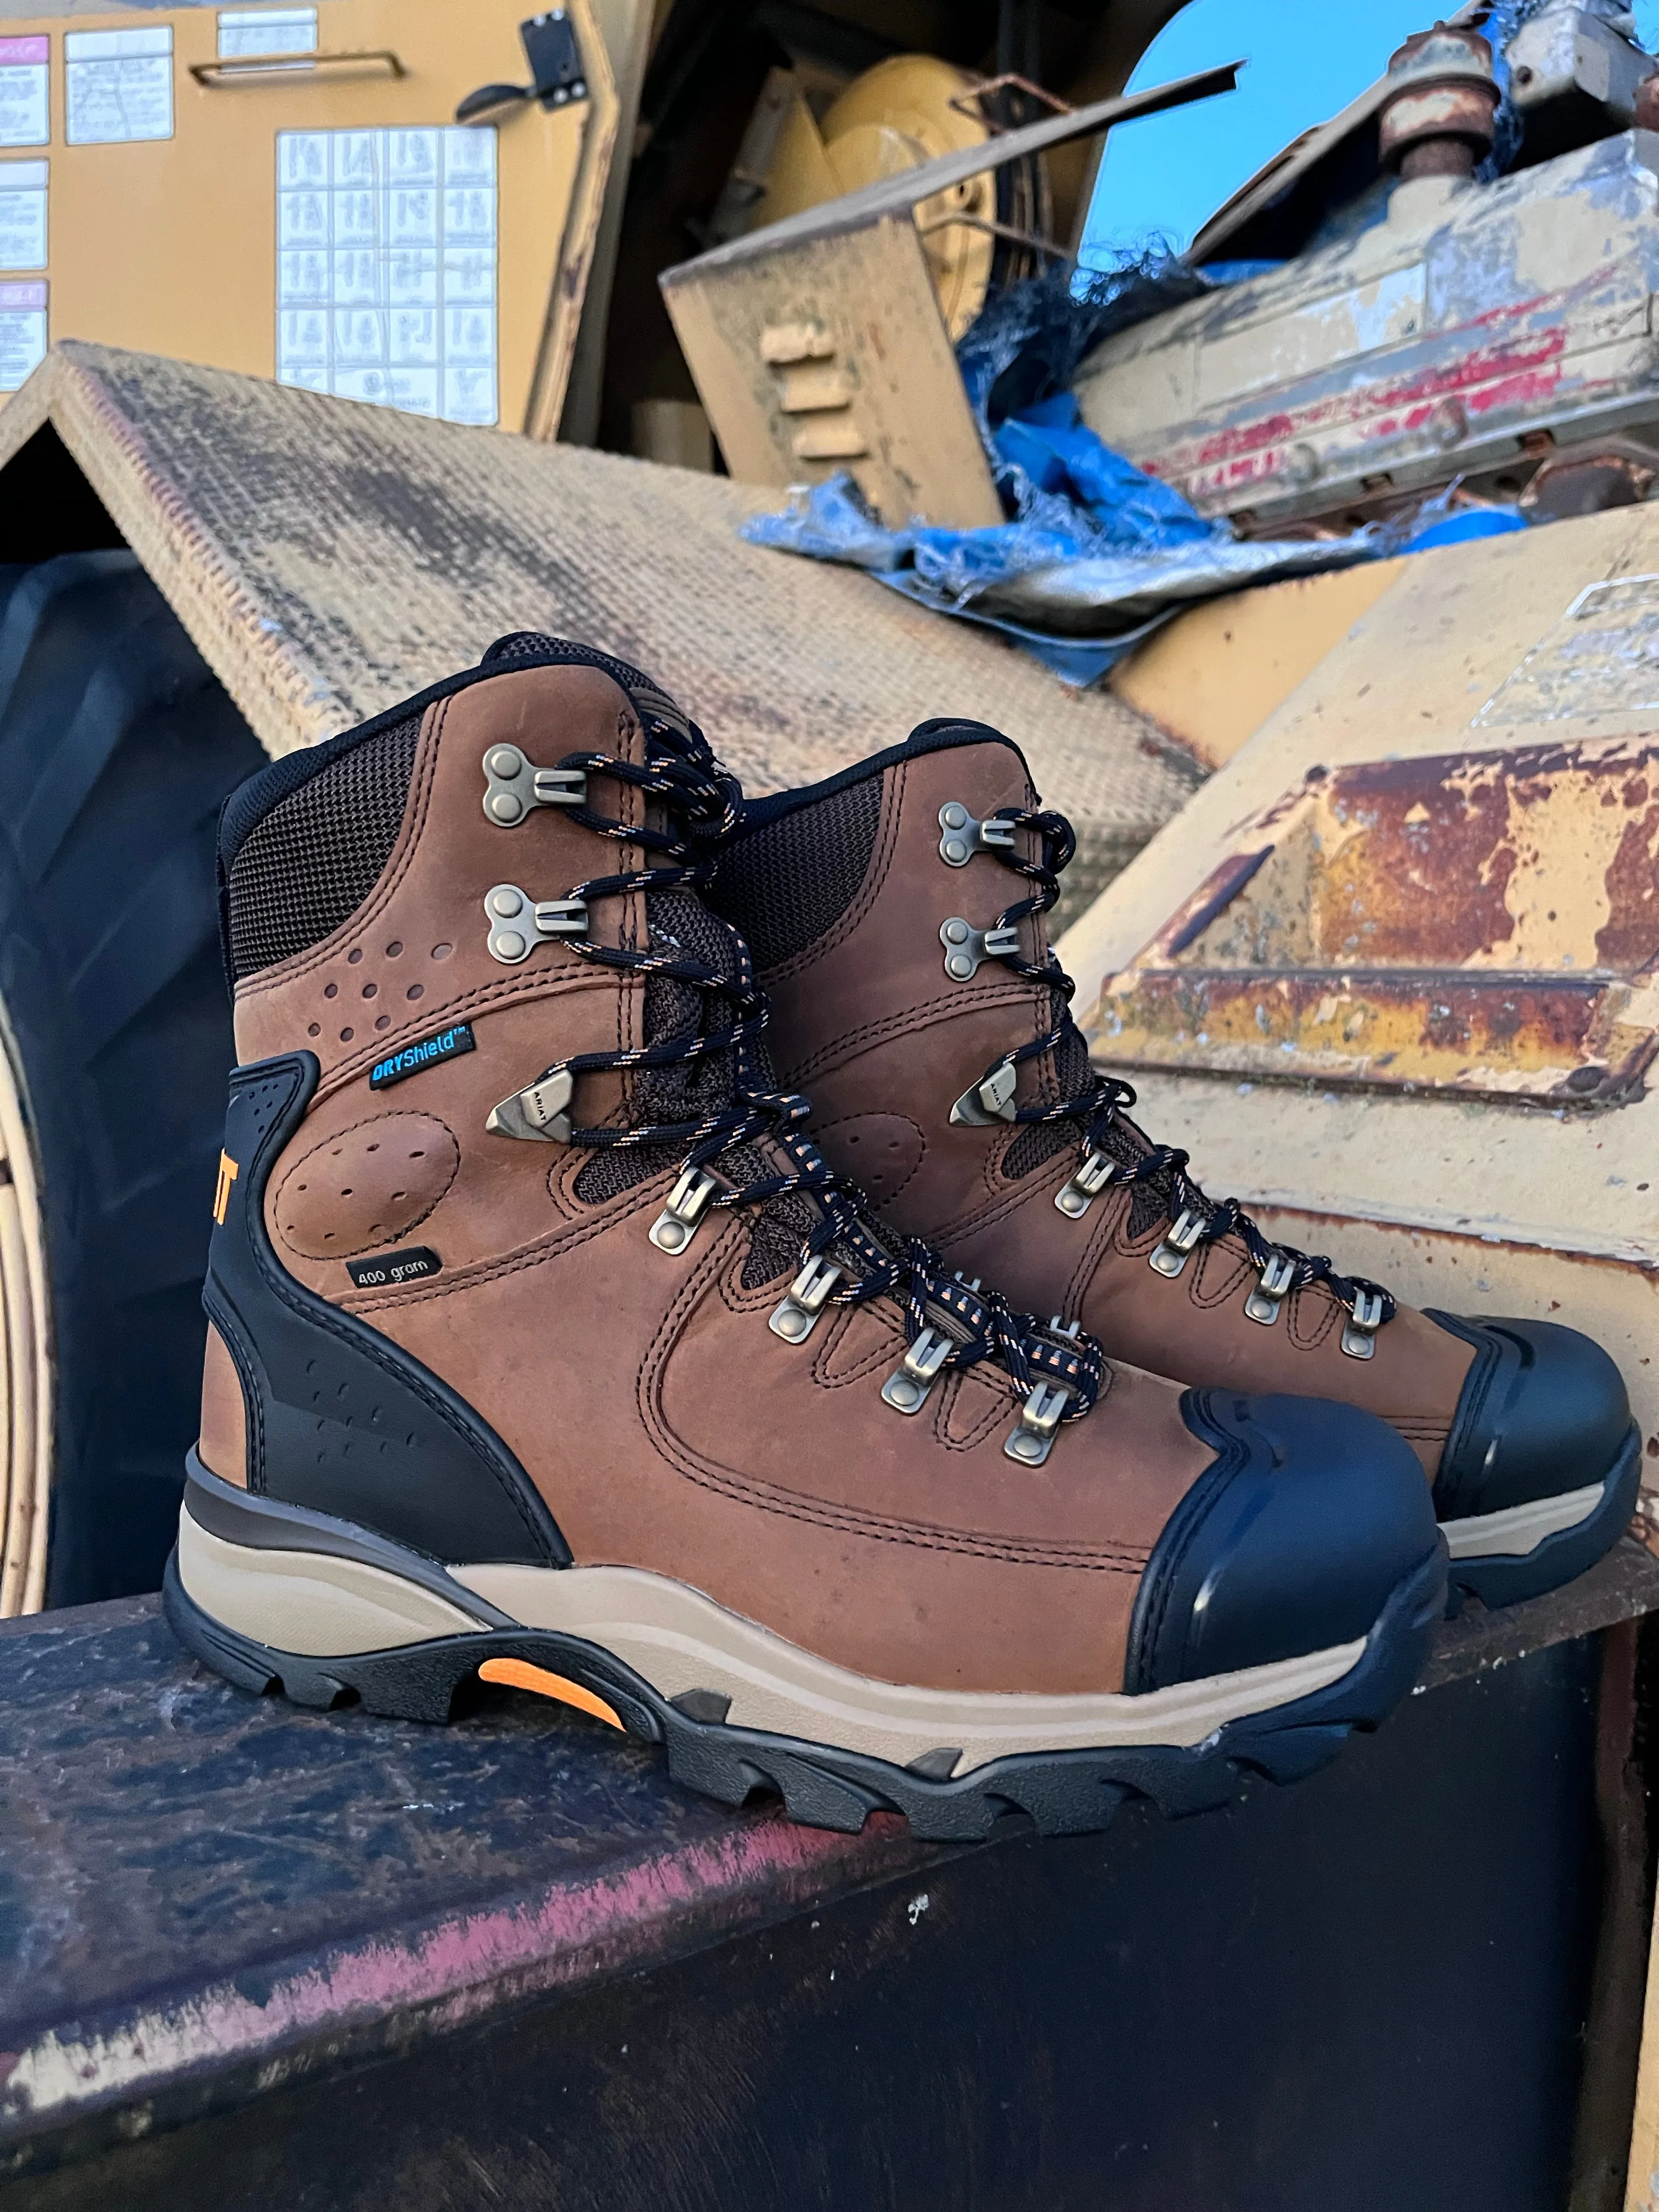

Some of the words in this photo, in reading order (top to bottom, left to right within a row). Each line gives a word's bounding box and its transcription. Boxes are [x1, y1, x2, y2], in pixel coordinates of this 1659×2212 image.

[534, 1091, 546, 1120] ARIAT
[990, 1084, 1002, 1106] ARIAT
[359, 1270, 386, 1284] 400
[390, 1261, 428, 1282] gram
